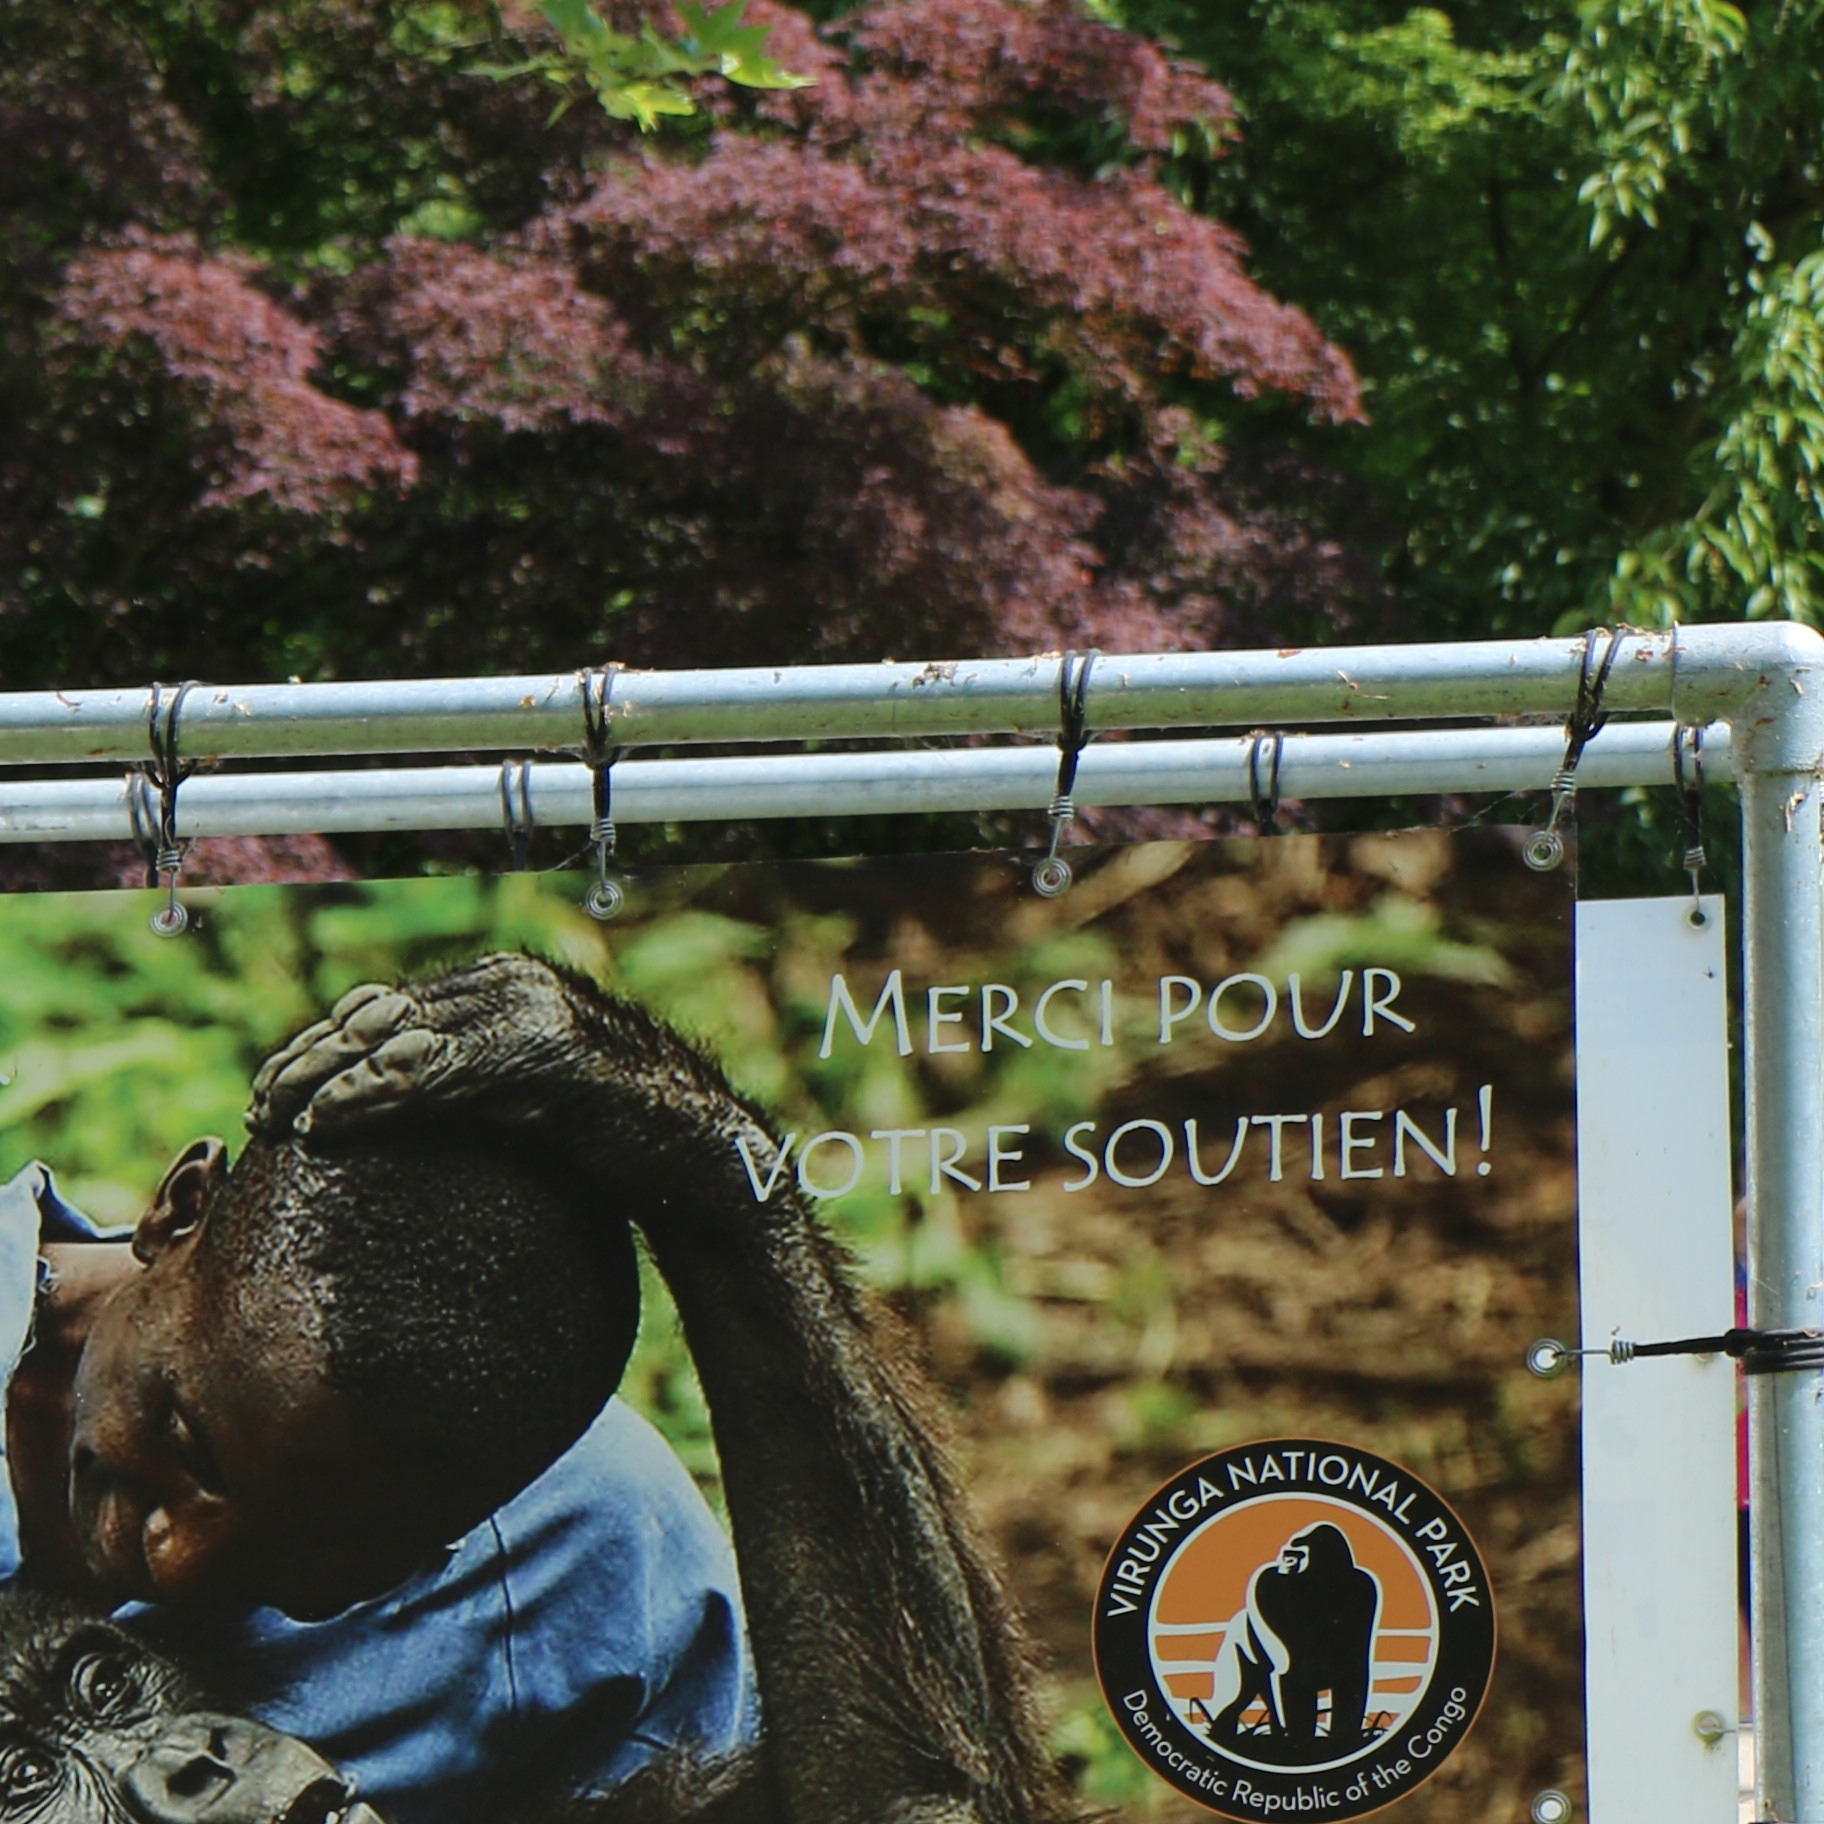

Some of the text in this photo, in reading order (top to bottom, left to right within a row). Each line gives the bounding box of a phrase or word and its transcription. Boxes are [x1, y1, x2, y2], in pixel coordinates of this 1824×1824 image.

[819, 967, 1416, 1060] MERCI POUR
[735, 1083, 1494, 1203] VOTRE SOUTIEN!
[1106, 1450, 1481, 1619] VIRUNGA NATIONAL PARK
[1122, 1686, 1467, 1815] Democratic Republic of the Congo
